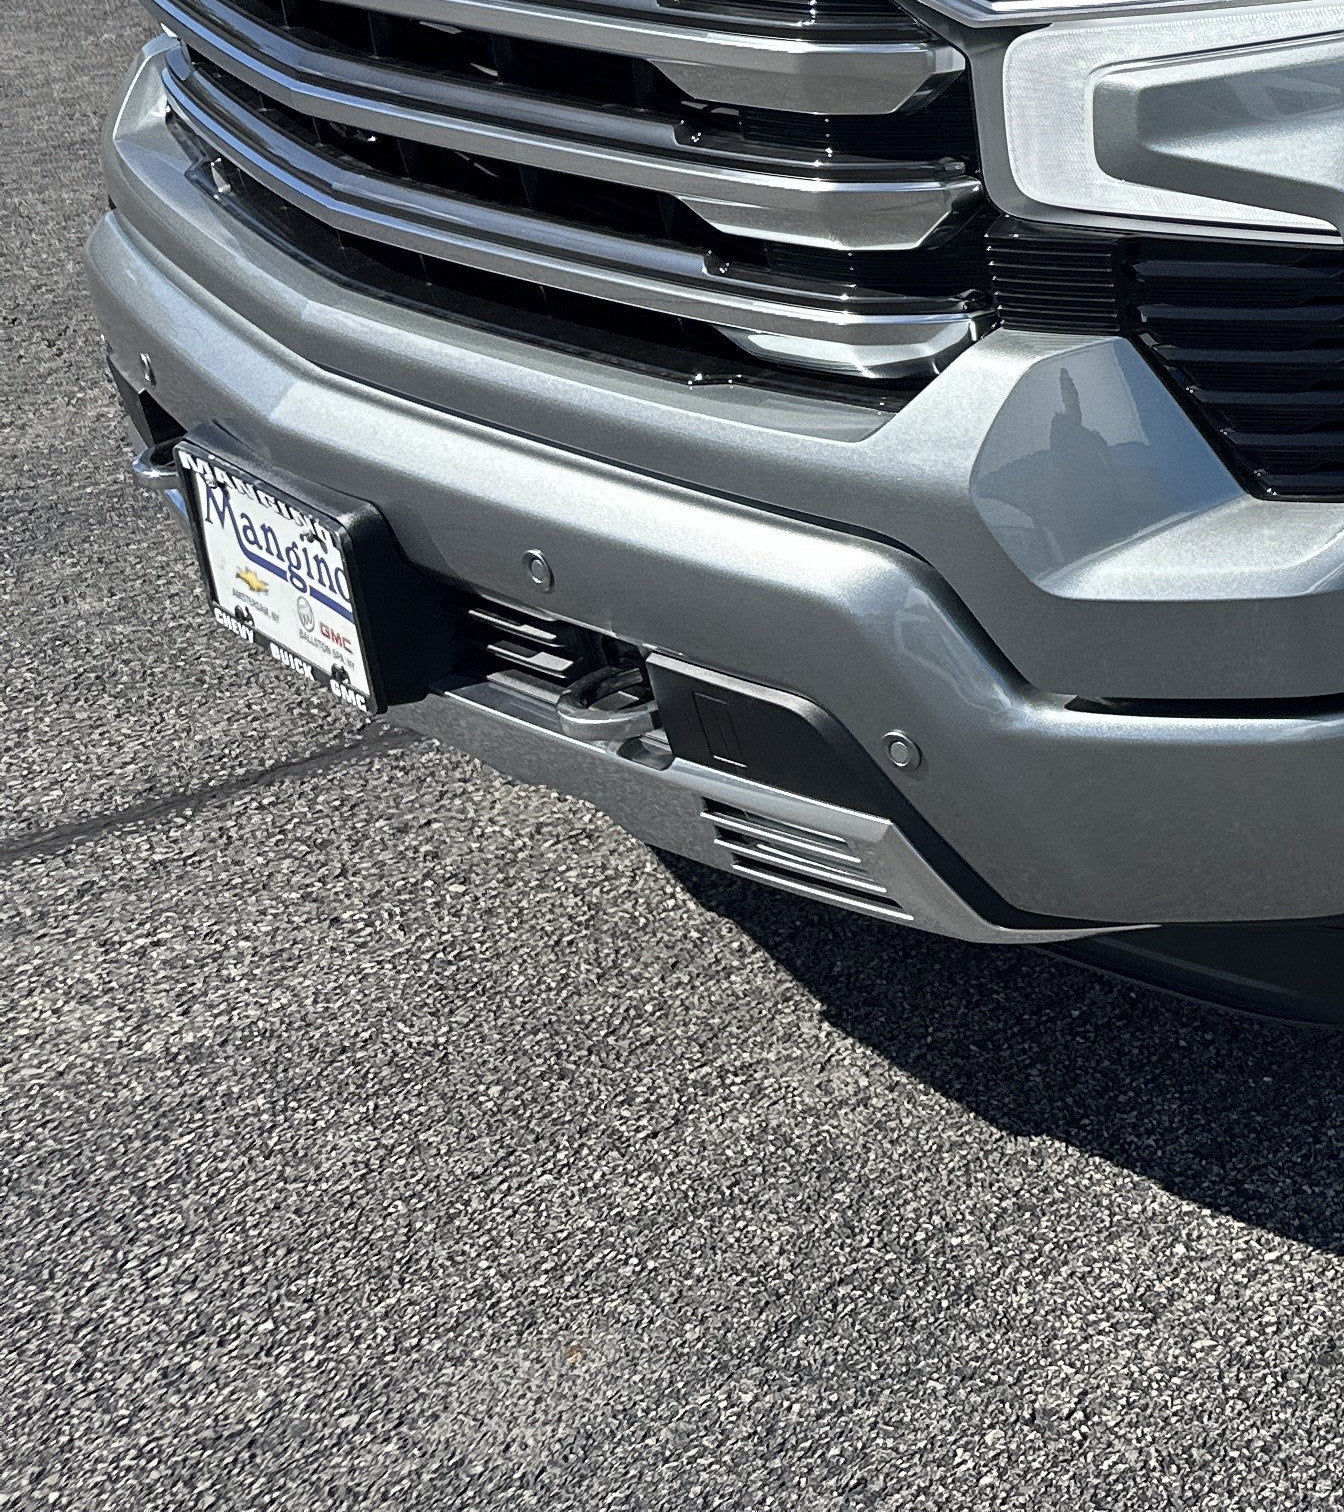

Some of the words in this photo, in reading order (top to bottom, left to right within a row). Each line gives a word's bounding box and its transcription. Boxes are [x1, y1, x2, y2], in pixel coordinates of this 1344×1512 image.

[178, 450, 336, 548] MANGINO
[203, 481, 352, 608] Mangino
[213, 606, 255, 644] CHEVY
[319, 621, 354, 655] GMC
[269, 642, 316, 682] BUICK
[329, 678, 368, 713] GMC
